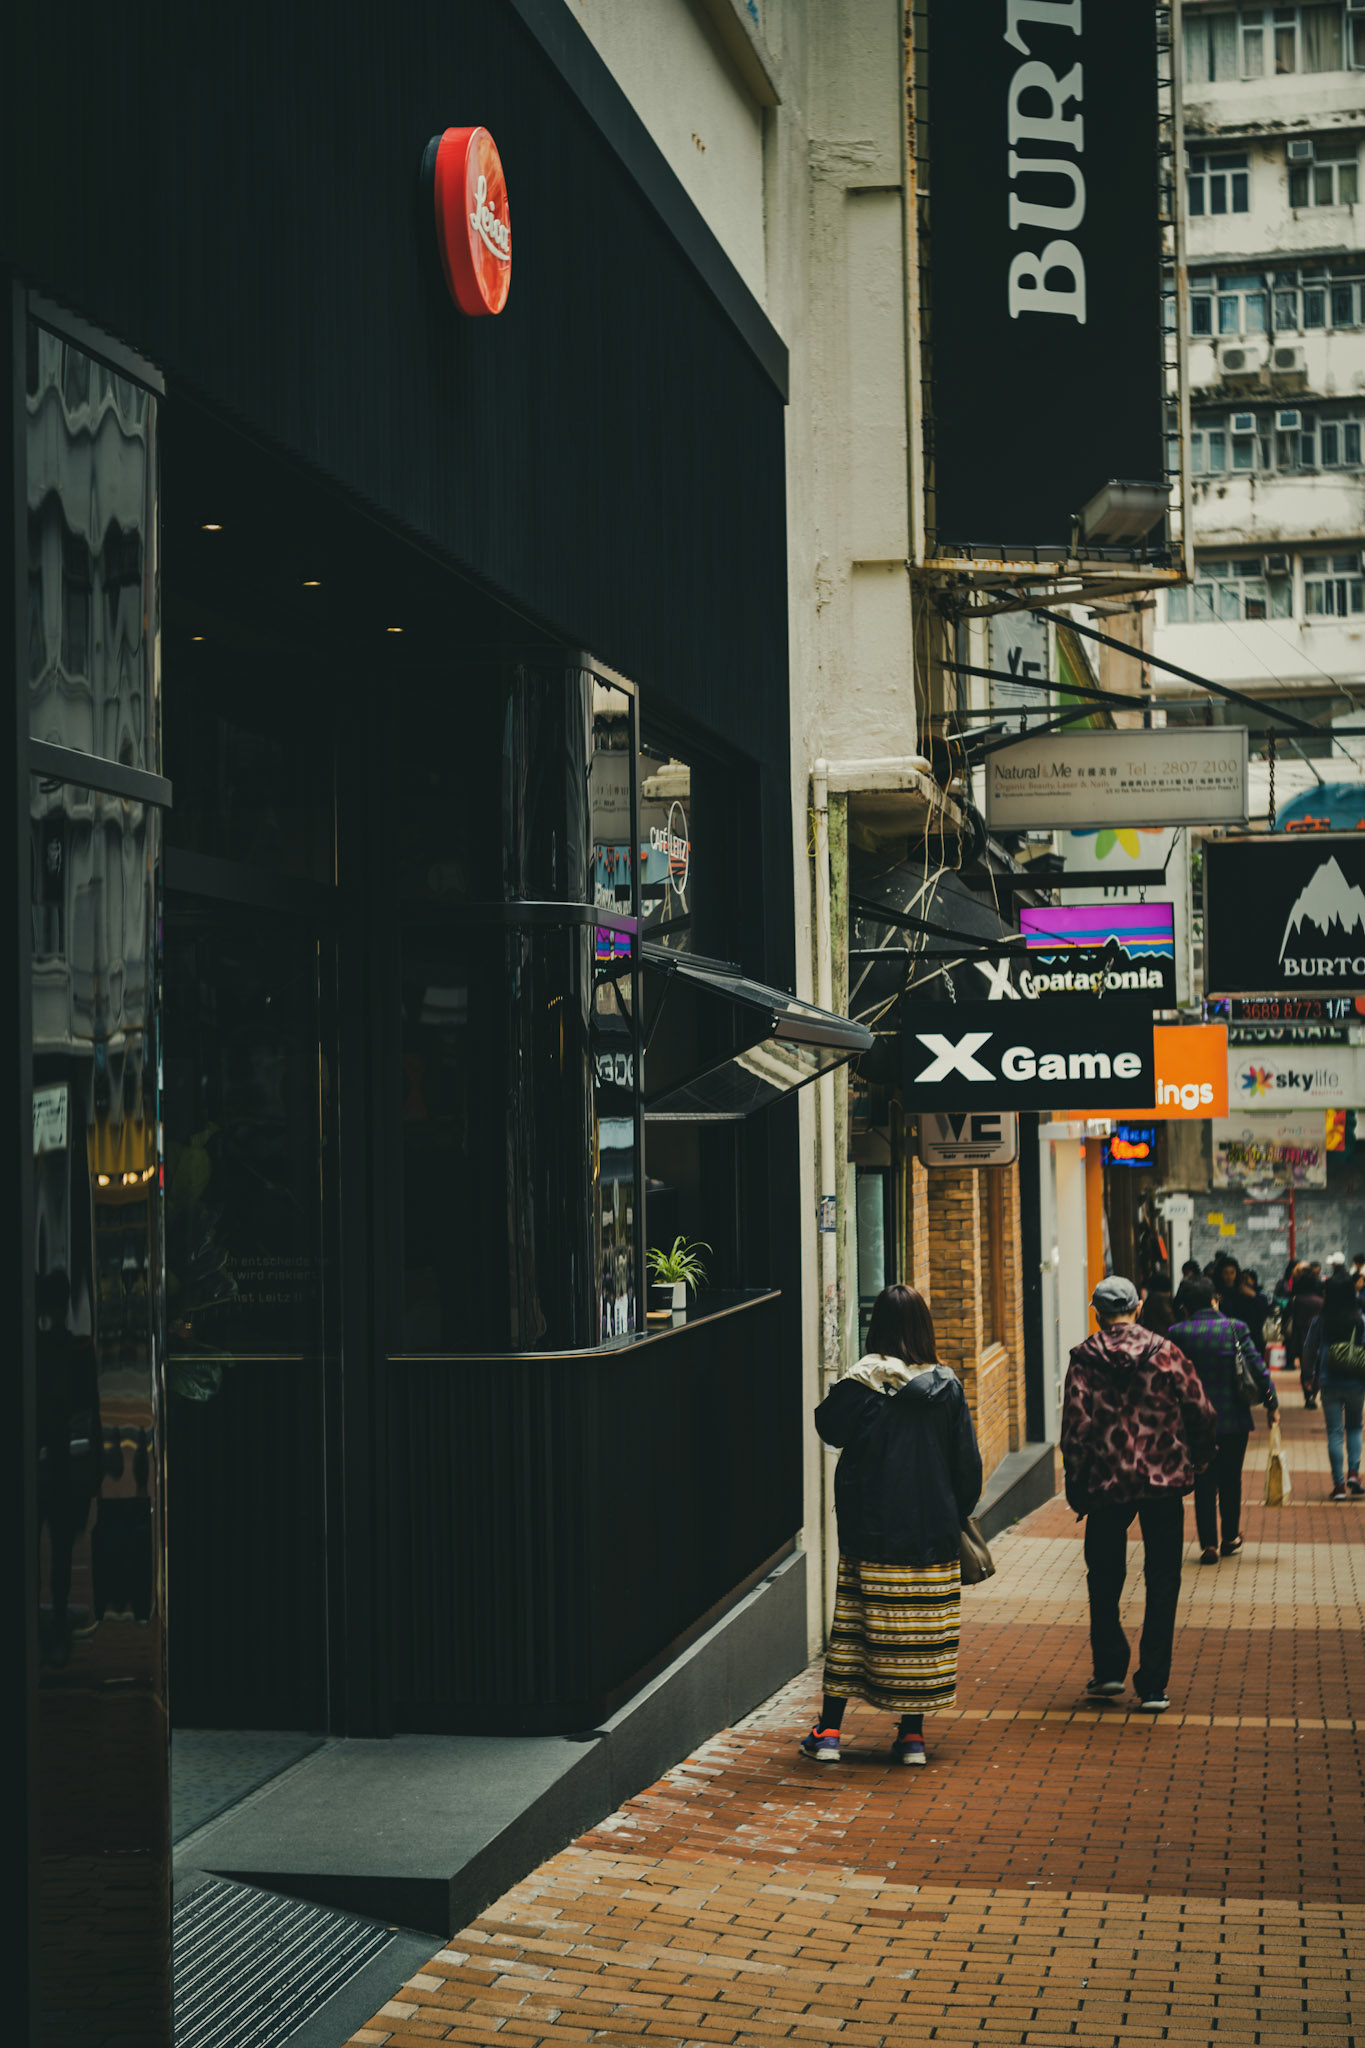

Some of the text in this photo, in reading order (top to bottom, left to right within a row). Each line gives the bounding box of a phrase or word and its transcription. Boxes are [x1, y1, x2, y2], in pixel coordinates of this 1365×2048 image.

[469, 175, 510, 260] Leica
[995, 763, 1041, 779] Natural
[1051, 762, 1072, 778] Me
[1126, 762, 1147, 776] Tel
[1162, 760, 1197, 775] 2807
[1203, 759, 1238, 774] 2100
[650, 826, 669, 855] CAFÉ
[1034, 967, 1164, 992] patagonia
[1242, 1001, 1280, 1020] 3689
[1284, 1001, 1322, 1019] 8773
[1326, 998, 1351, 1019] 1/F
[914, 1032, 1142, 1082] X Game
[1157, 1079, 1214, 1110] ings
